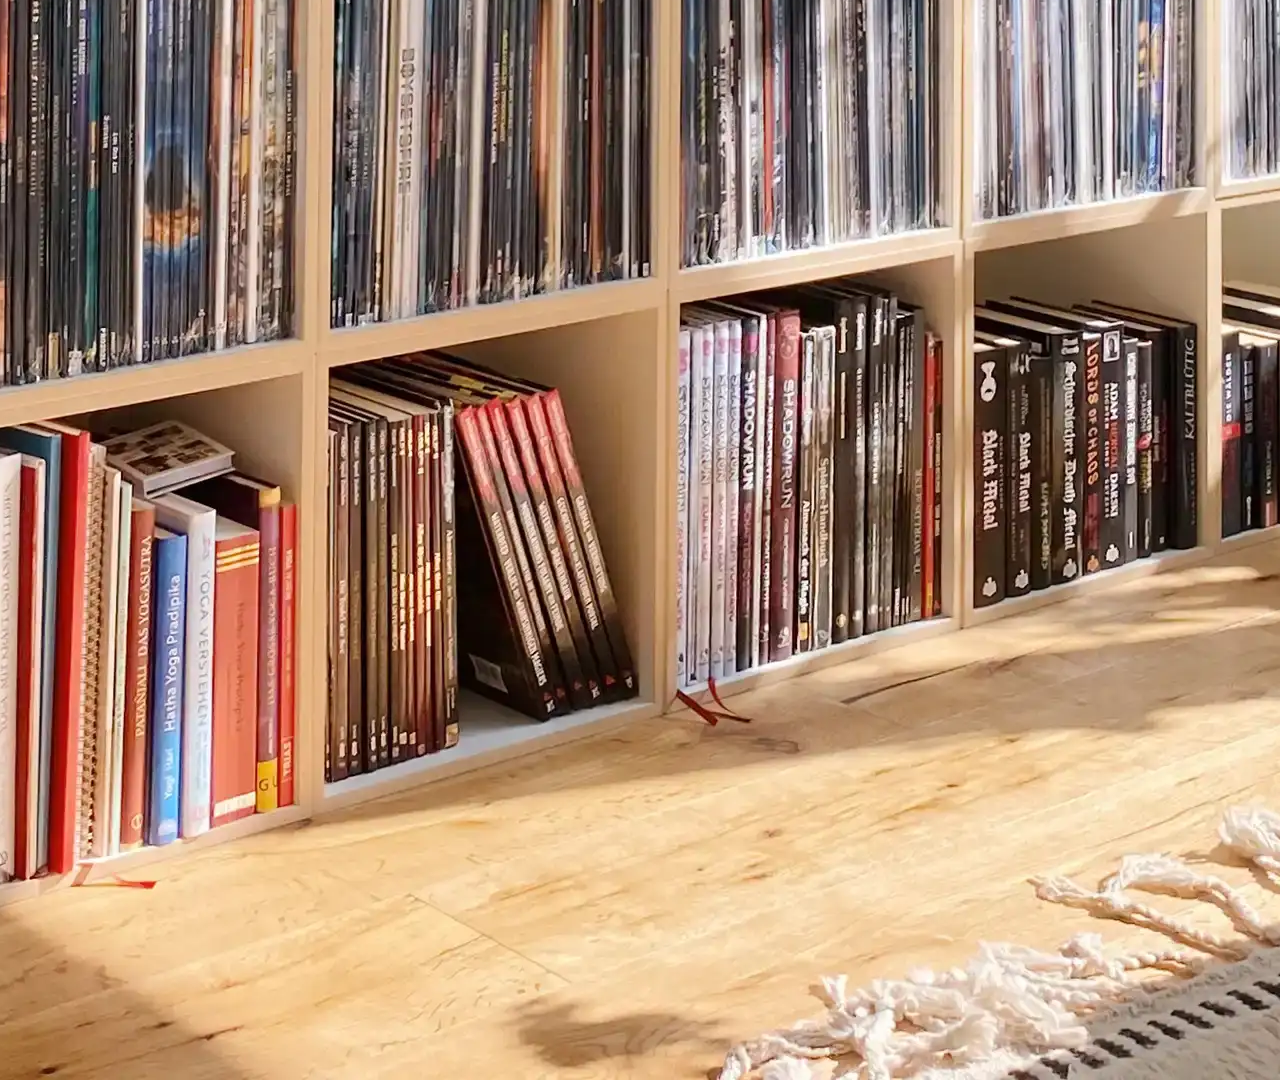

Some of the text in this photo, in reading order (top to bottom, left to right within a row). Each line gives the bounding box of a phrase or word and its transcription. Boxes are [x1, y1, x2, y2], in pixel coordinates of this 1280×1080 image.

[1086, 340, 1100, 405] LORDS
[1109, 382, 1119, 420] ADAM
[1182, 338, 1196, 440] KALTBLÜTIG
[1225, 402, 1233, 422] DIE
[700, 376, 713, 486] SHADOWRUN
[716, 373, 728, 484] SHADOWRUN
[729, 373, 740, 481] SHADOWRUN
[741, 369, 756, 491] SHADOWRUN
[780, 378, 795, 509] SHADOWRUN
[1062, 360, 1077, 551] Schwedischer Death Metal
[1086, 427, 1099, 486] CHAOS
[818, 457, 831, 568] Spieler-Handbuch
[981, 429, 999, 531] Black Metal
[1018, 432, 1031, 513] Black Metal
[1109, 473, 1119, 517] DARSKI
[138, 536, 152, 625] YOGASUTRA
[266, 547, 278, 625] YOGA-BUCH
[799, 499, 812, 615] Almanach der Magie
[137, 627, 149, 656] DAS
[166, 575, 182, 644] Pradipika
[196, 570, 210, 727] YOGA VERSTEHEN
[165, 648, 180, 685] Yoga
[164, 687, 177, 732] Hatha
[164, 776, 175, 800] Yogi
[281, 741, 293, 777] TRIAS
